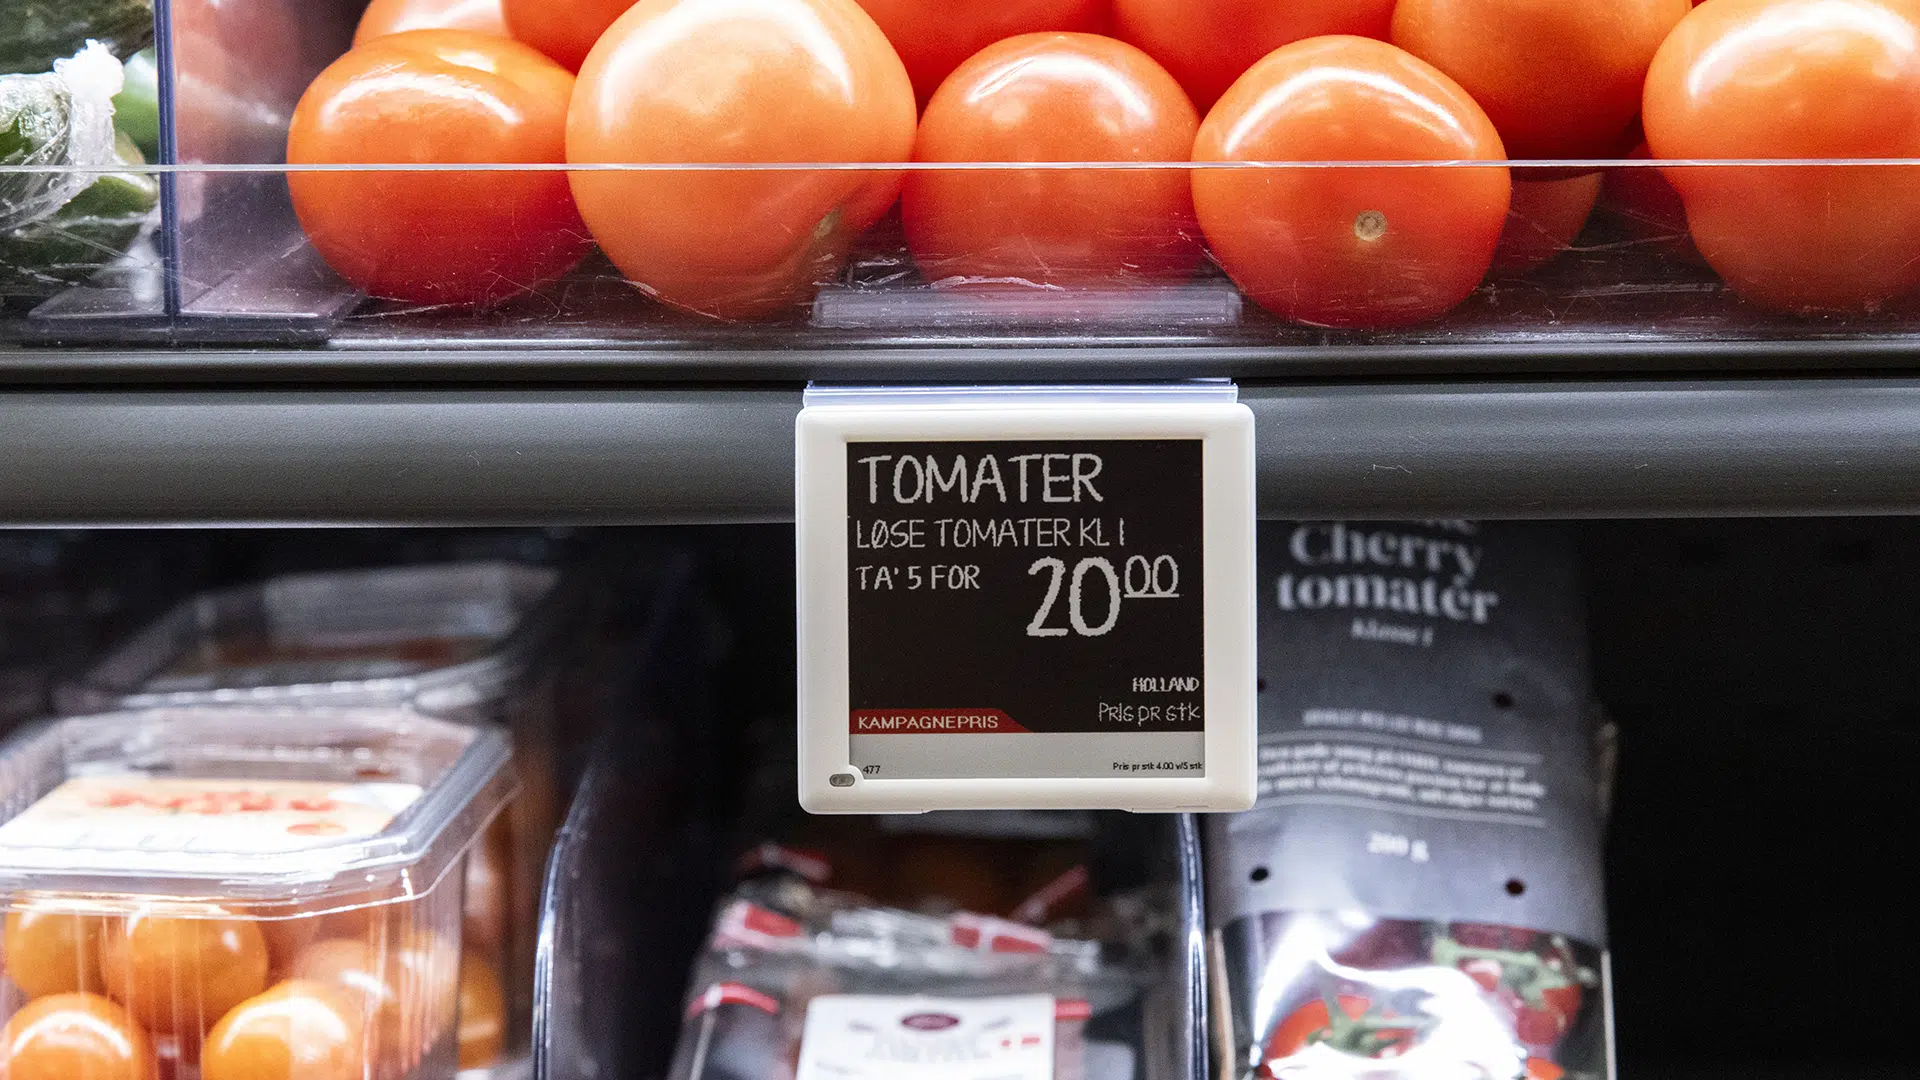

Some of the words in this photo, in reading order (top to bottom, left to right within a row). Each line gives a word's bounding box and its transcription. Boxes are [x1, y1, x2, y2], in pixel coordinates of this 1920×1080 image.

[857, 453, 1104, 503] TOMATER
[856, 519, 926, 549] LØSE
[933, 518, 1071, 548] TOMATER
[1079, 518, 1111, 546] KL
[1288, 523, 1484, 588] Cherry
[907, 565, 922, 590] 5
[931, 565, 981, 590] FOR
[1276, 573, 1500, 625] tomater
[1132, 677, 1200, 692] HOLLAND
[858, 715, 999, 729] KAMPAGNEPRIS
[862, 764, 881, 775] 477
[1112, 762, 1130, 771] Pris
[1131, 764, 1141, 773] pr
[1141, 761, 1155, 771] stk
[1156, 761, 1174, 771] 4.00
[1189, 761, 1203, 771] stk
